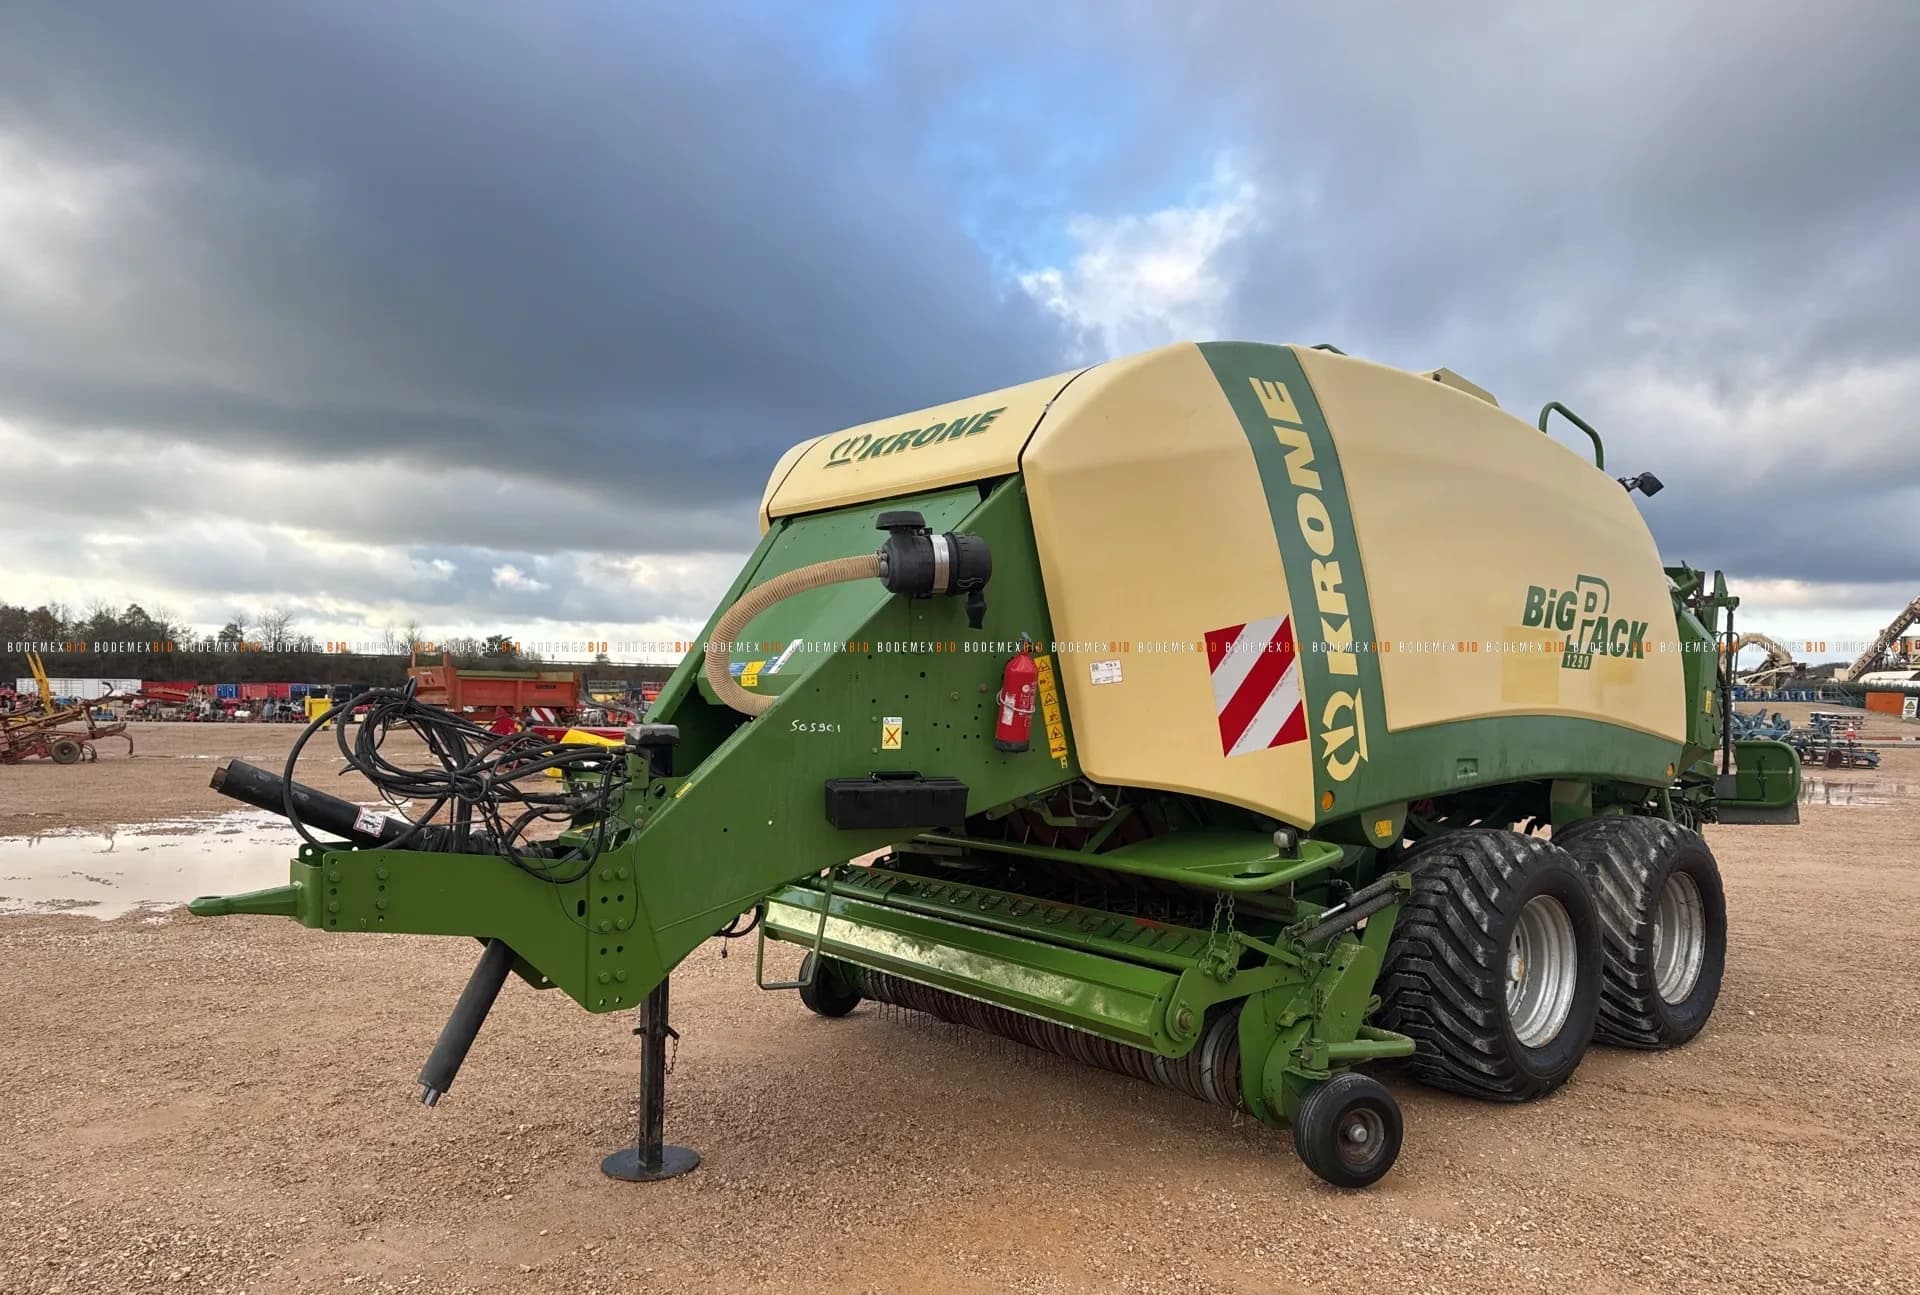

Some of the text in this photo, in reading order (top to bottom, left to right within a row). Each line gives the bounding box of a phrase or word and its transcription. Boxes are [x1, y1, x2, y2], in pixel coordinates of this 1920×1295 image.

[857, 406, 1009, 462] KRONE
[1249, 376, 1359, 676] KRONE
[1565, 574, 1649, 659] PACK
[1567, 654, 1589, 669] 1290
